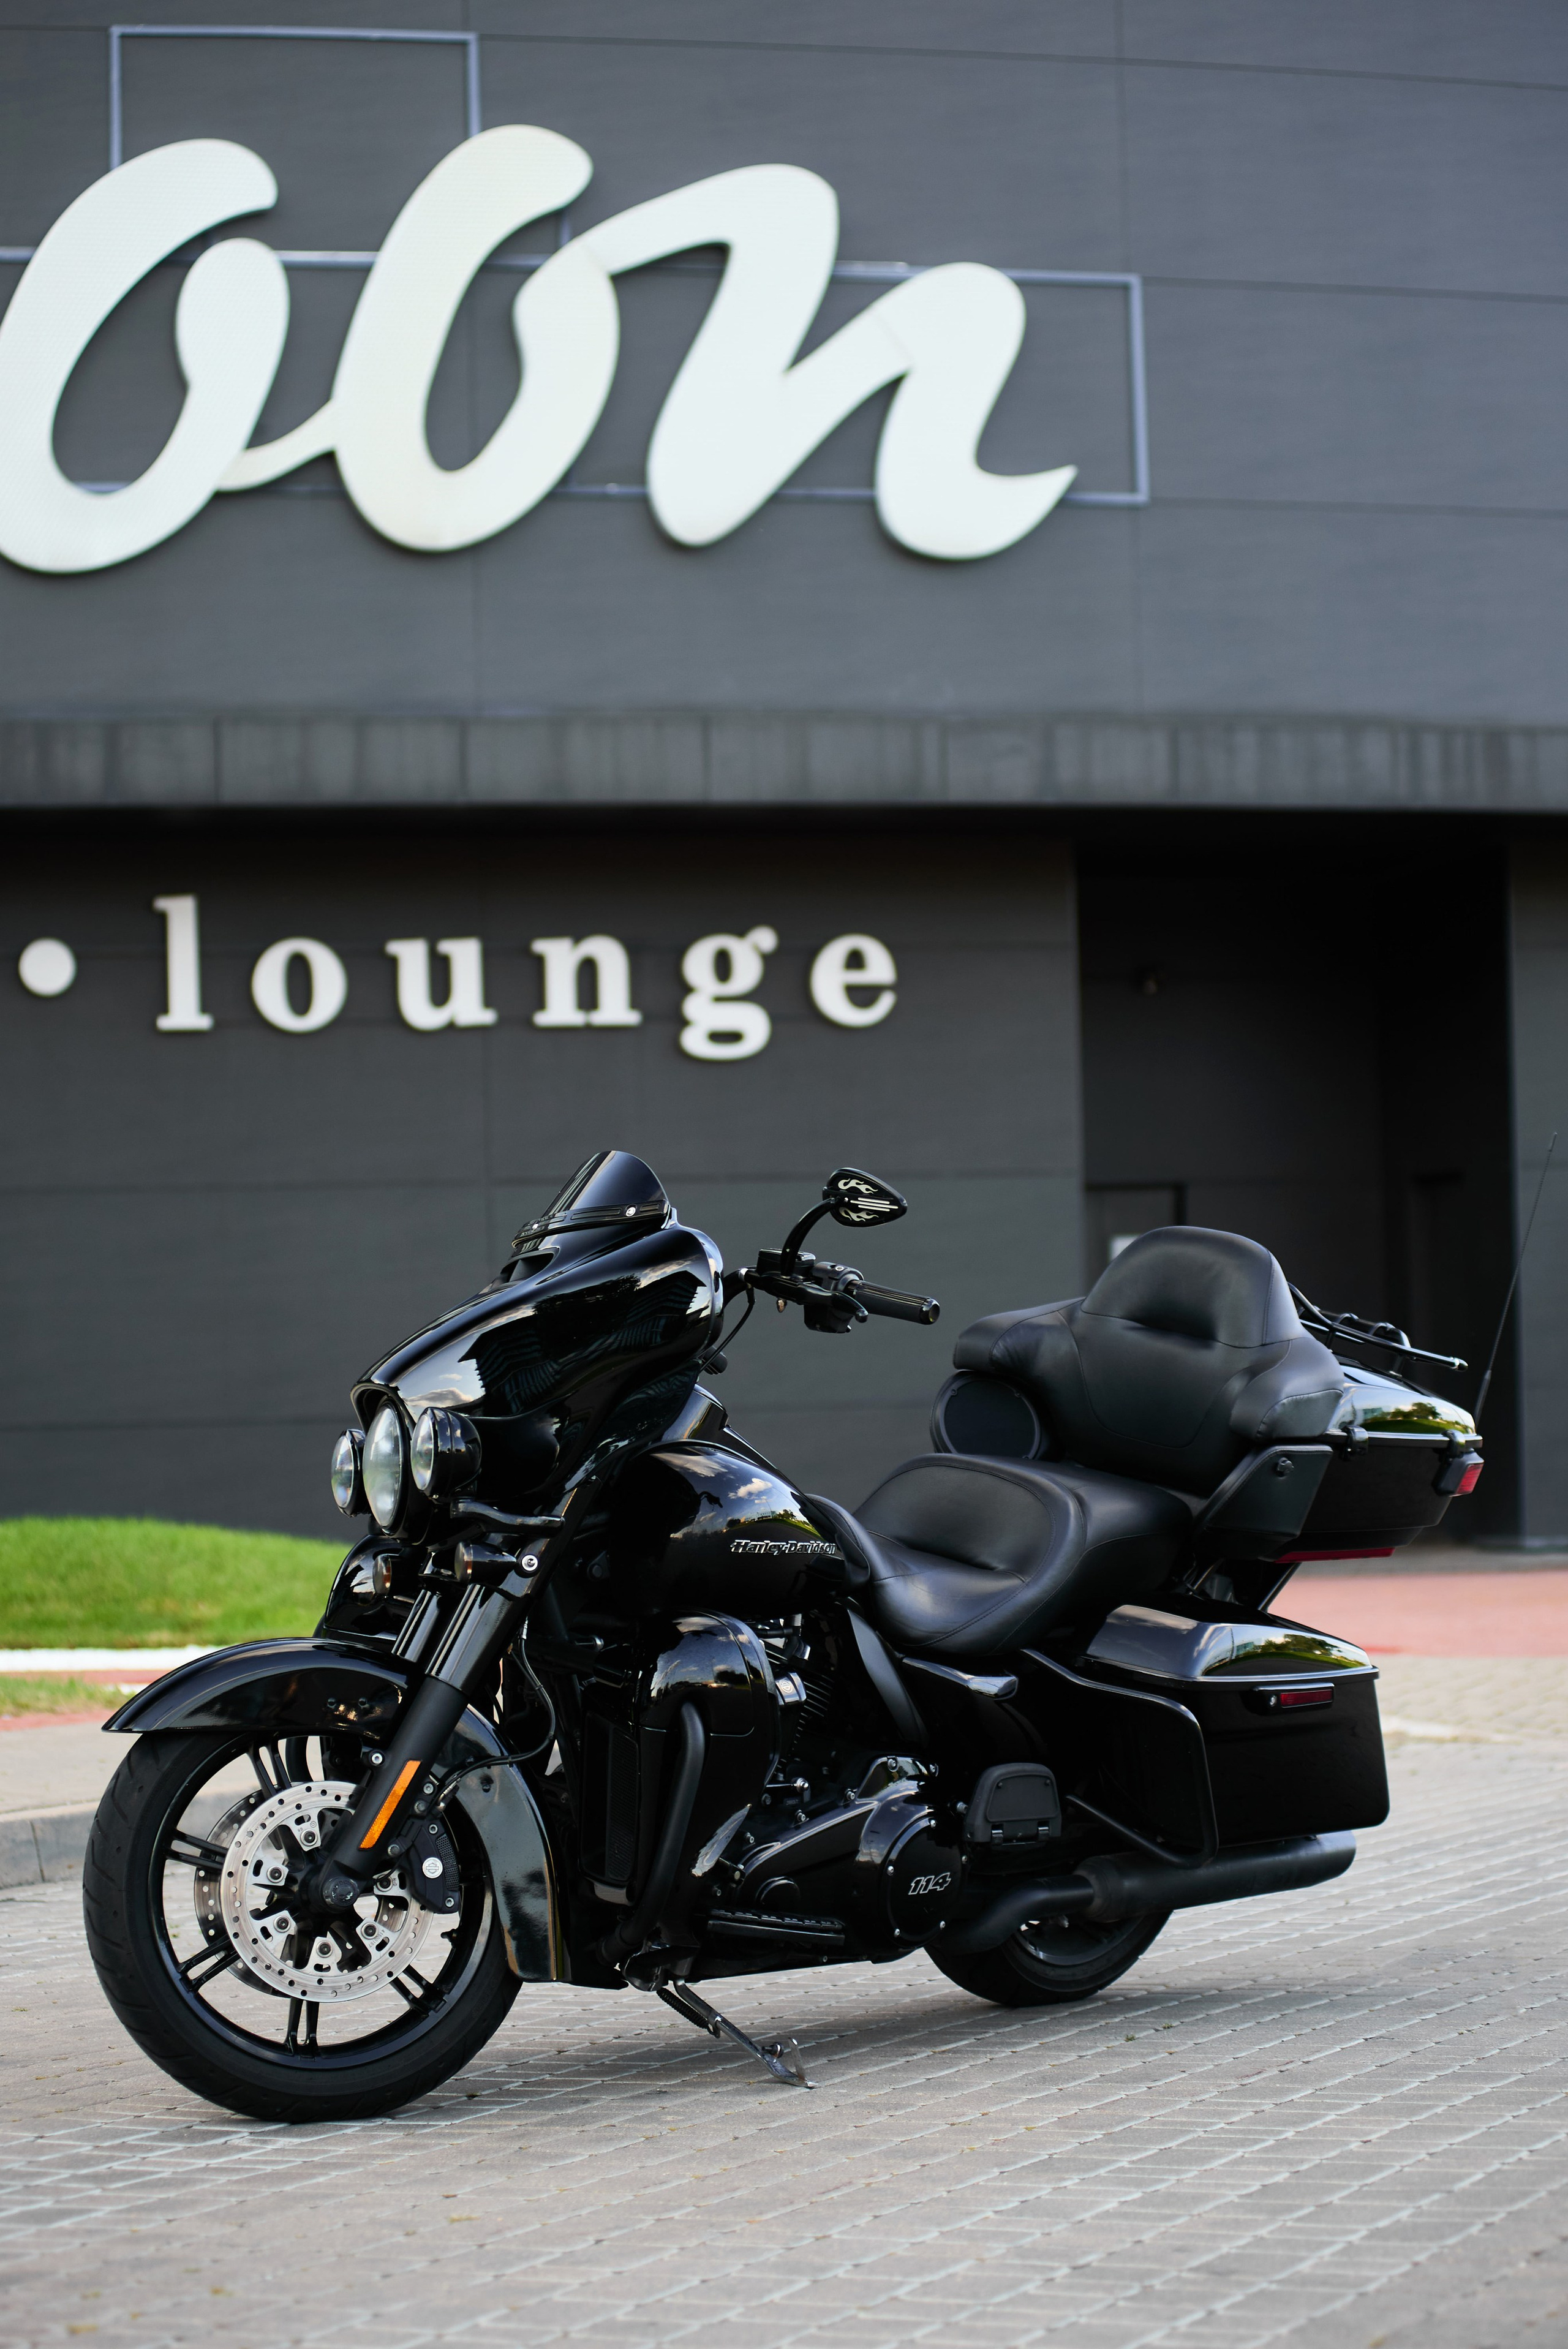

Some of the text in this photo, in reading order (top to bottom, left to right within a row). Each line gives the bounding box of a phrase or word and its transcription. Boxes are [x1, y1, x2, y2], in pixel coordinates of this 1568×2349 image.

[154, 894, 898, 1061] lounge
[729, 1539, 837, 1556] Harley-Davidson
[908, 1872, 952, 1896] 114
